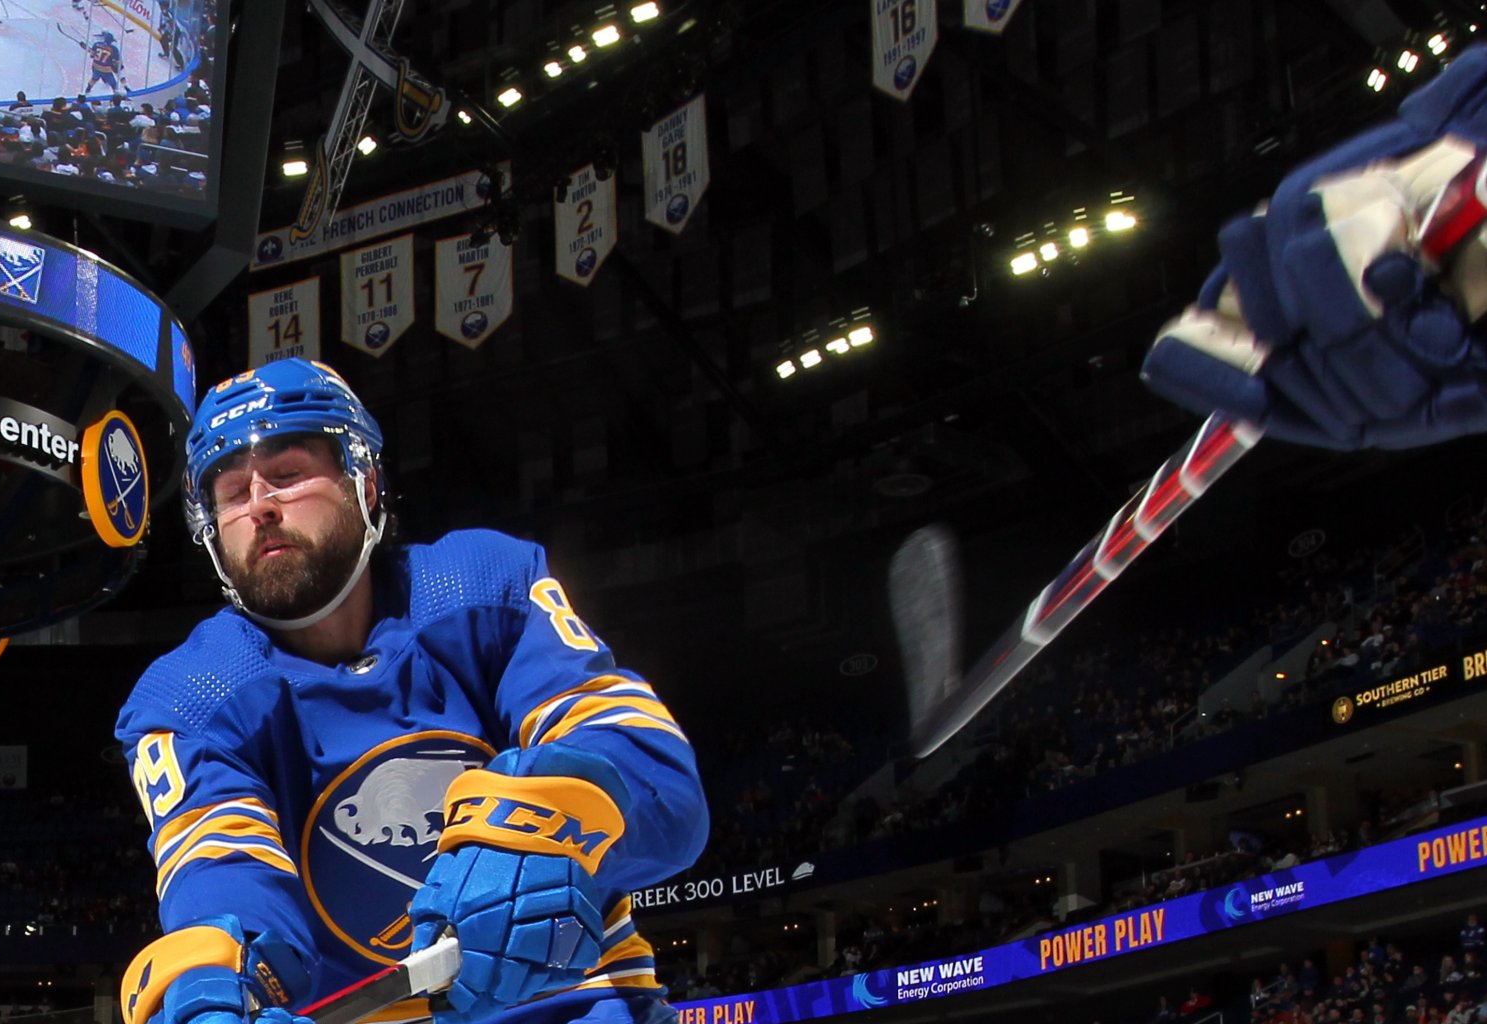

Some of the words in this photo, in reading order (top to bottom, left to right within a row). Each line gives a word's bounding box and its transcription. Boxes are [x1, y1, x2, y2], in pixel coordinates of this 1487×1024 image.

[890, 0, 916, 43] 16
[658, 110, 688, 138] DANNY
[578, 171, 591, 186] TIM
[663, 141, 687, 182] 18
[323, 209, 374, 242] FRENCH
[378, 185, 465, 224] CONNECTION
[576, 200, 593, 235] 2
[355, 256, 398, 278] PERREAULT
[361, 245, 392, 265] GILBERT
[458, 247, 489, 265] MARTIN
[360, 273, 392, 308] 11
[463, 263, 486, 298] 7
[269, 300, 298, 318] ROBERT
[267, 313, 303, 349] 14
[210, 393, 273, 430] CCM
[529, 576, 600, 652] 8
[1355, 675, 1419, 707] SOUTHERN
[1420, 665, 1448, 684] TIER
[1381, 690, 1412, 708] BREWING
[1414, 687, 1425, 697] CO
[447, 795, 610, 858] CCM
[1417, 828, 1487, 872] POWE
[632, 883, 680, 909] REEK
[683, 878, 724, 901] 300
[732, 867, 785, 894] LEVEL
[1250, 890, 1274, 904] NEW
[1275, 881, 1304, 897] WAVE
[1251, 901, 1270, 913] Energy
[1271, 893, 1305, 908] Corporation
[1040, 924, 1107, 970] POWER
[1114, 908, 1165, 951] PLAY
[897, 966, 935, 987] NEW
[939, 956, 984, 980] WAVE
[897, 984, 930, 1000] Energy
[930, 975, 984, 994] Corporation
